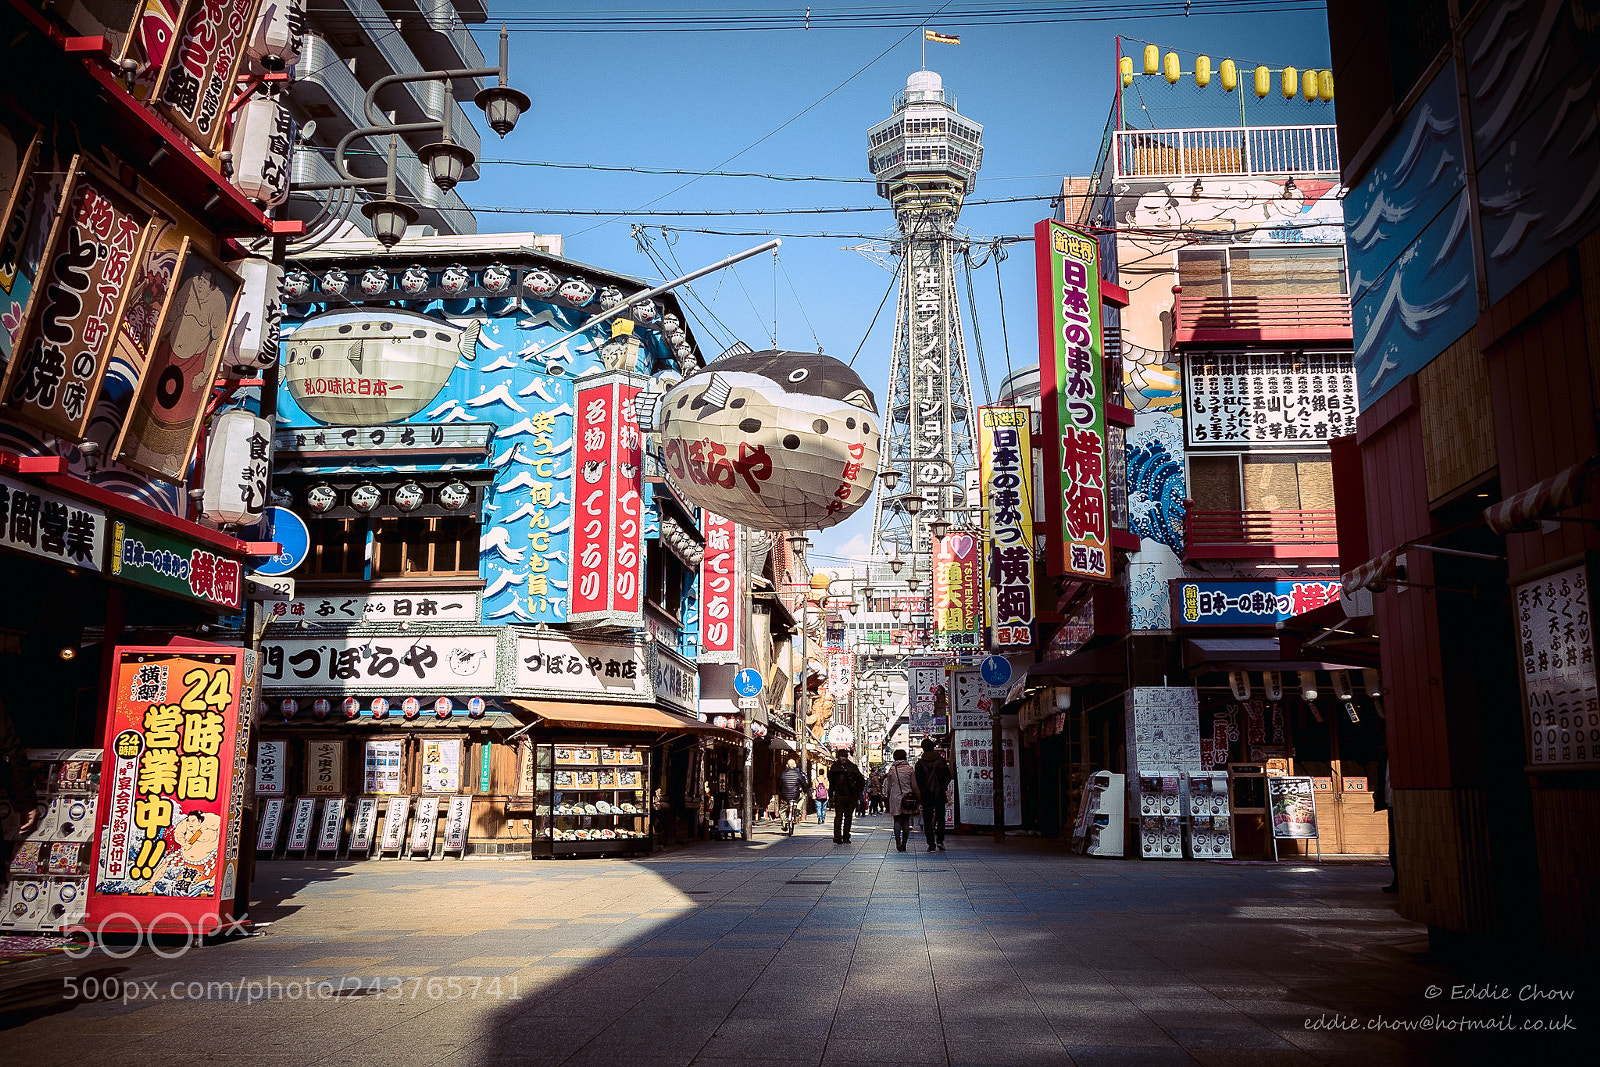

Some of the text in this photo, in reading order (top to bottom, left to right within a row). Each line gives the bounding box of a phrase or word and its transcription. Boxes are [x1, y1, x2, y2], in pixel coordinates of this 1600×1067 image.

[1055, 231, 1092, 261] 新世界
[65, 217, 138, 418] 大阪下町の味
[304, 378, 403, 397] 私の味は日本一
[584, 399, 606, 452] 名物
[984, 411, 1026, 428] 新世界
[1193, 397, 1207, 440] もち
[1223, 396, 1238, 440] 紅しょうが
[1237, 397, 1252, 440] にんにく
[1252, 396, 1267, 440] 玉ねぎ
[1283, 396, 1297, 440] しし唐
[1297, 395, 1312, 439] れんこん
[1312, 395, 1327, 439] 銀杏
[664, 436, 772, 493] づぼらや
[527, 411, 555, 614] 安うて何んでも旨い
[1073, 545, 1104, 572] 酒処
[964, 561, 974, 631] TSUTENKAKU
[1185, 585, 1199, 622] 新世界
[1531, 586, 1548, 671] 天丼
[1545, 583, 1563, 669] ふぐ天ぷら
[1560, 578, 1577, 667] ふぐ天丼
[1574, 573, 1592, 665] ふぐカツ丼
[138, 666, 161, 701] 横綱
[524, 653, 638, 679] づぼらや本店
[120, 735, 140, 746] 24
[240, 686, 254, 754] MONEY
[118, 747, 139, 757] 時間
[109, 777, 132, 877] 宴会予約受付中
[231, 757, 246, 861] EXCHANGE
